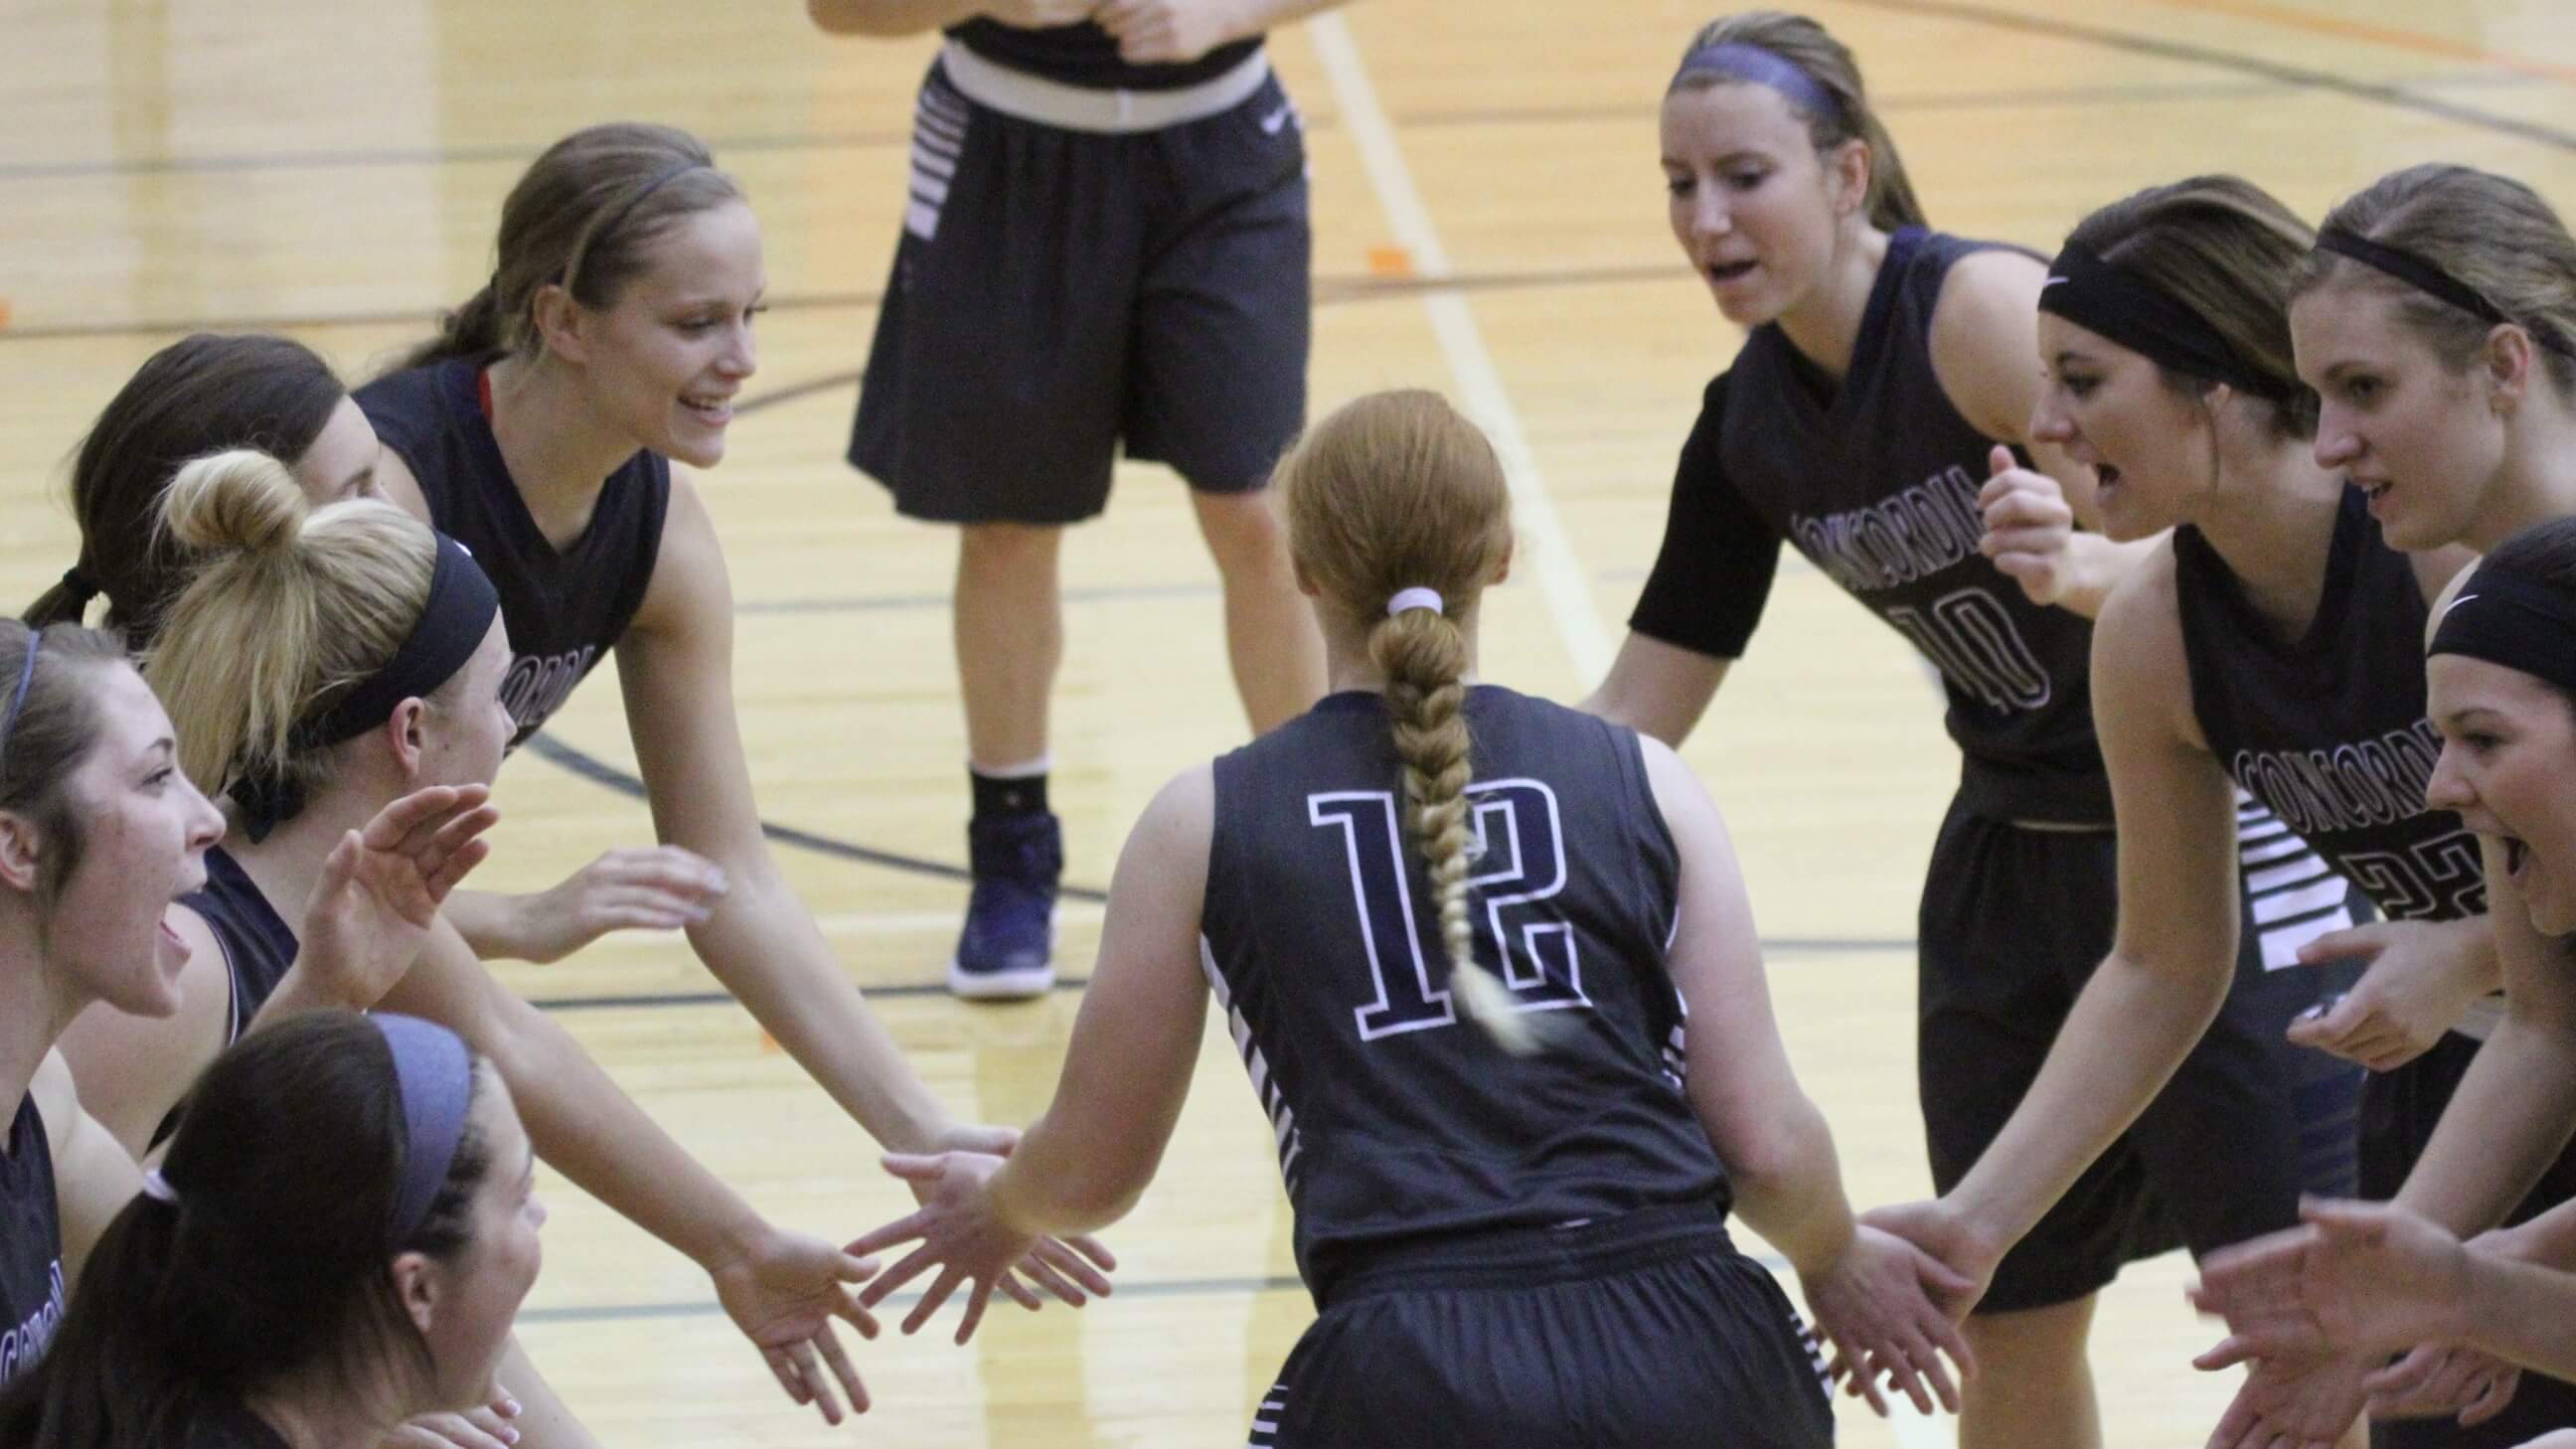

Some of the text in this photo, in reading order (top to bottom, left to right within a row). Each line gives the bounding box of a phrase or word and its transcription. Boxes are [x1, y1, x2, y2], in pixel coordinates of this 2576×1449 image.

[1887, 587, 2051, 715] 10
[1307, 777, 1592, 1042] 12
[2338, 829, 2488, 919] 22
